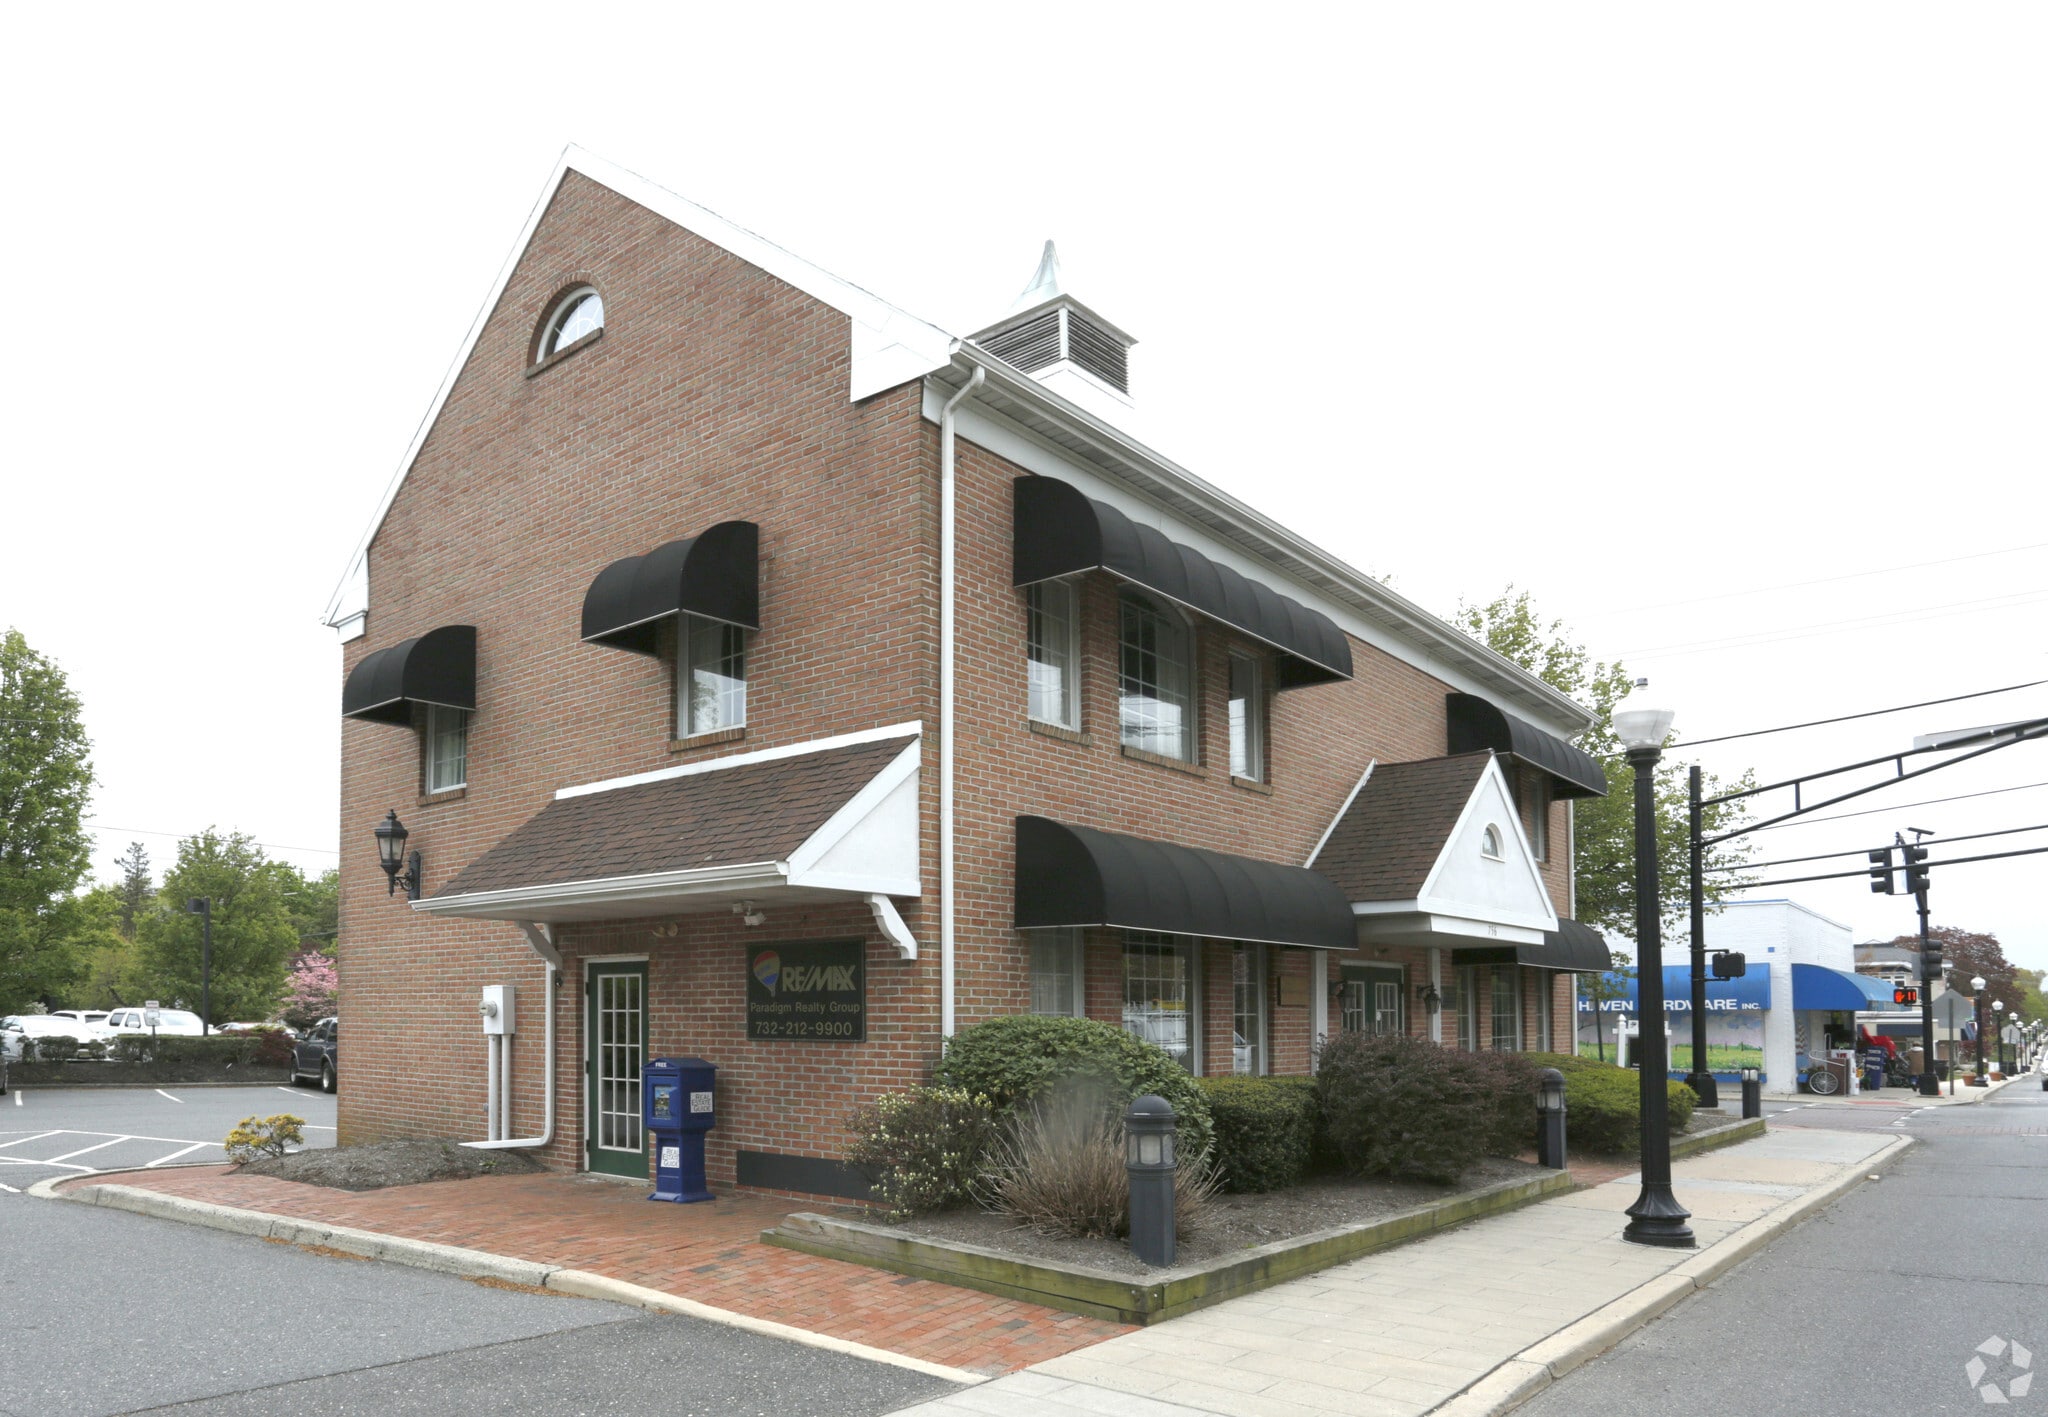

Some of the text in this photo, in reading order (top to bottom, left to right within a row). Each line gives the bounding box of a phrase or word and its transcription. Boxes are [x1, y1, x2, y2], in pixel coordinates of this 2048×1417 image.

[782, 965, 856, 992] RE/MAX
[750, 1001, 860, 1015] Paradigm Realty Group
[1662, 999, 1738, 1011] RDARE
[755, 1021, 853, 1036] 732-212-9900
